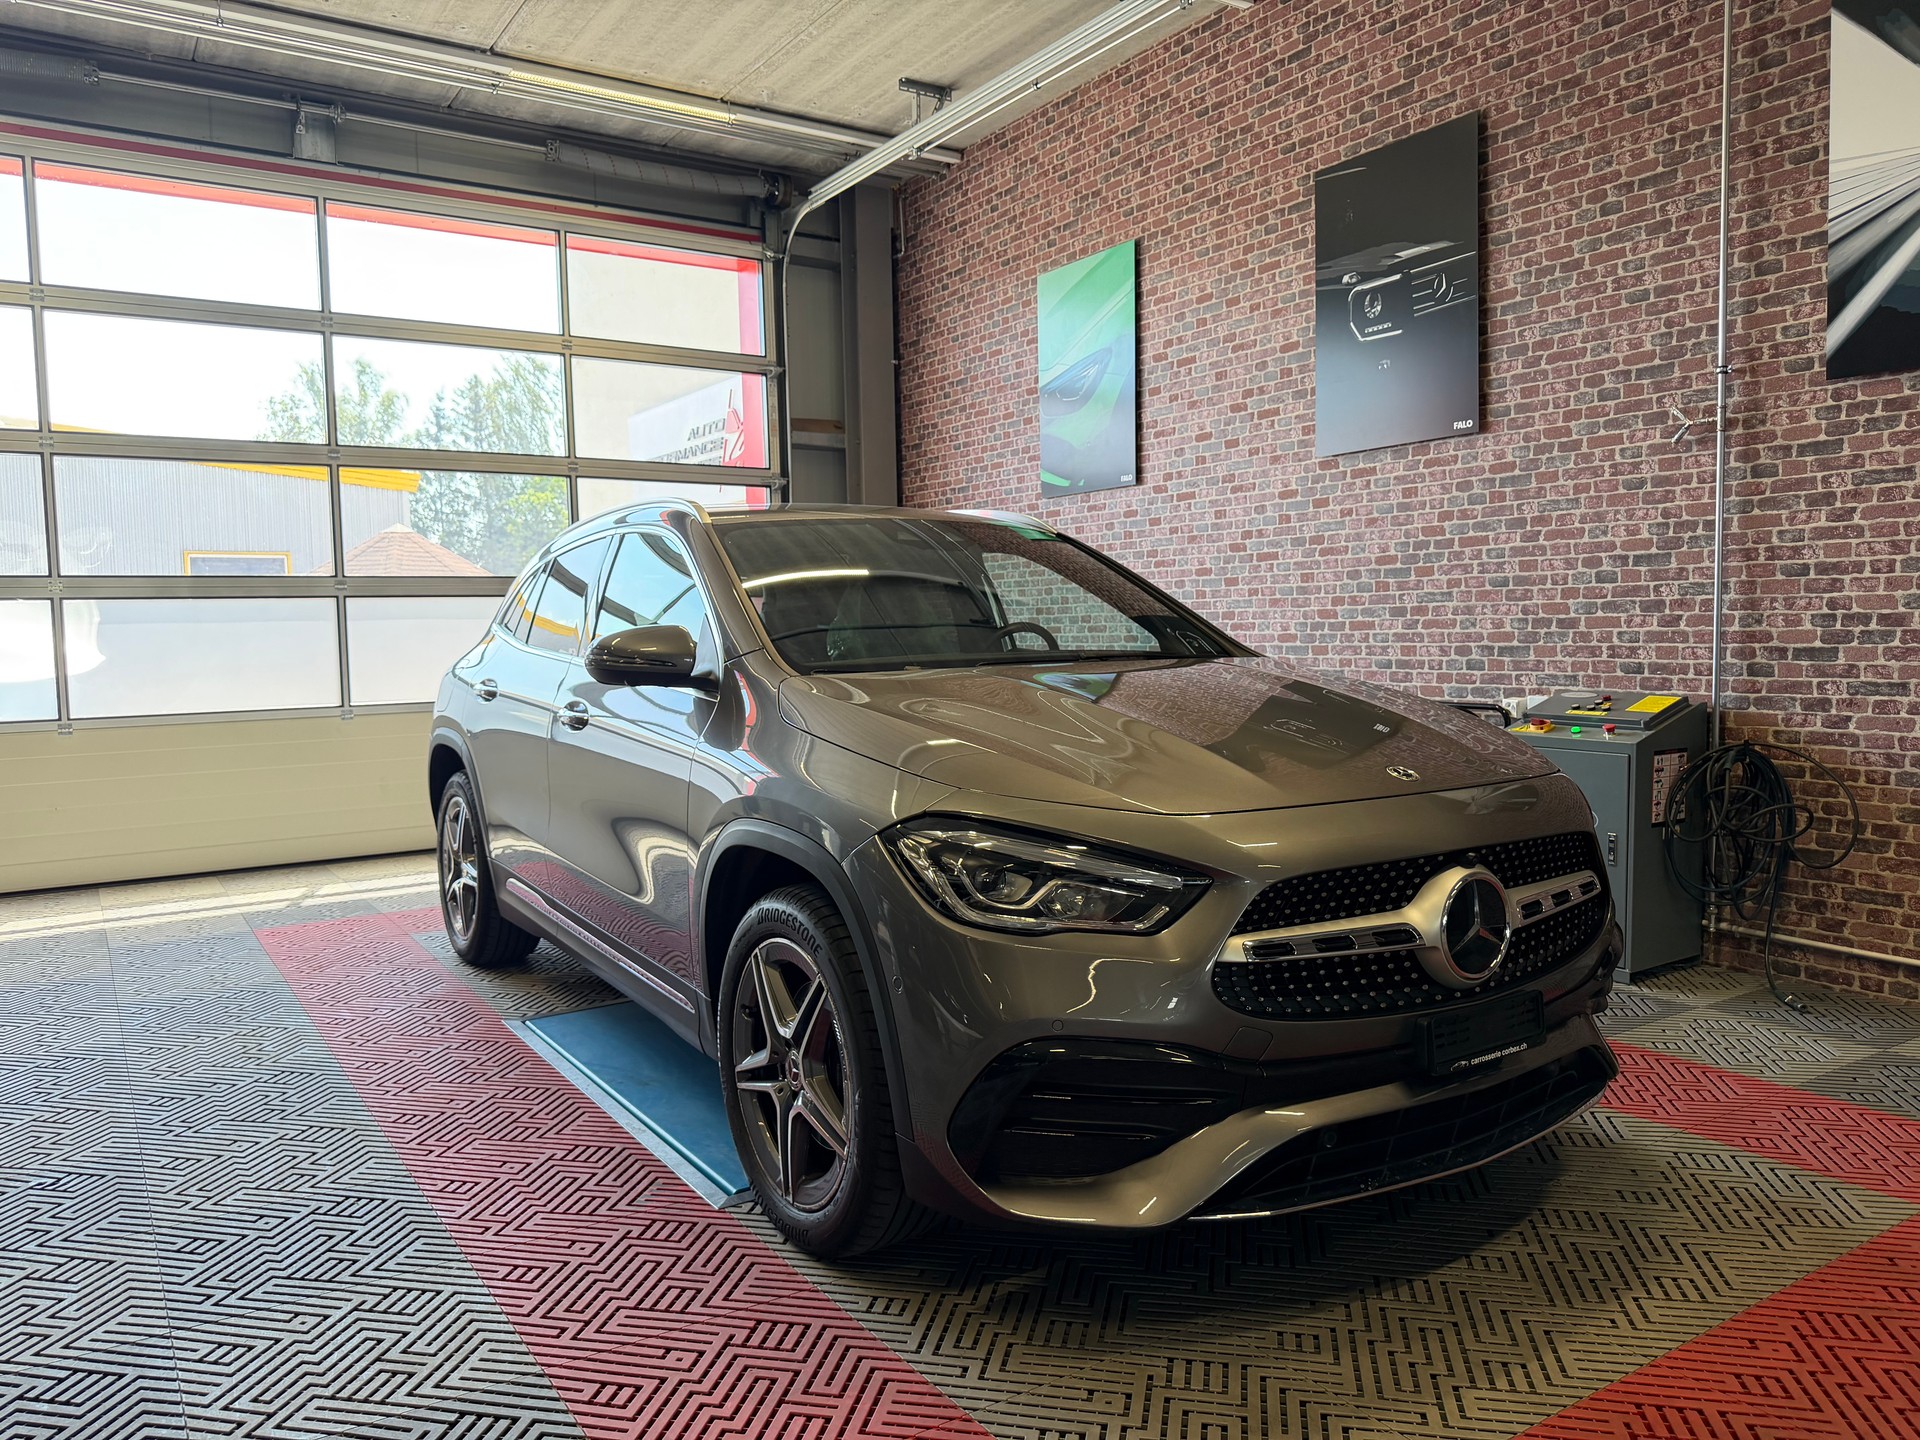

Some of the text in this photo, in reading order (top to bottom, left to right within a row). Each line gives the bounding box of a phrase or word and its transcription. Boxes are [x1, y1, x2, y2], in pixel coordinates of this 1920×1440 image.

[687, 418, 726, 441] AUTO
[1453, 419, 1473, 430] FALO
[756, 907, 823, 958] BRIDGESTONE
[1470, 1050, 1501, 1065] carrosserie
